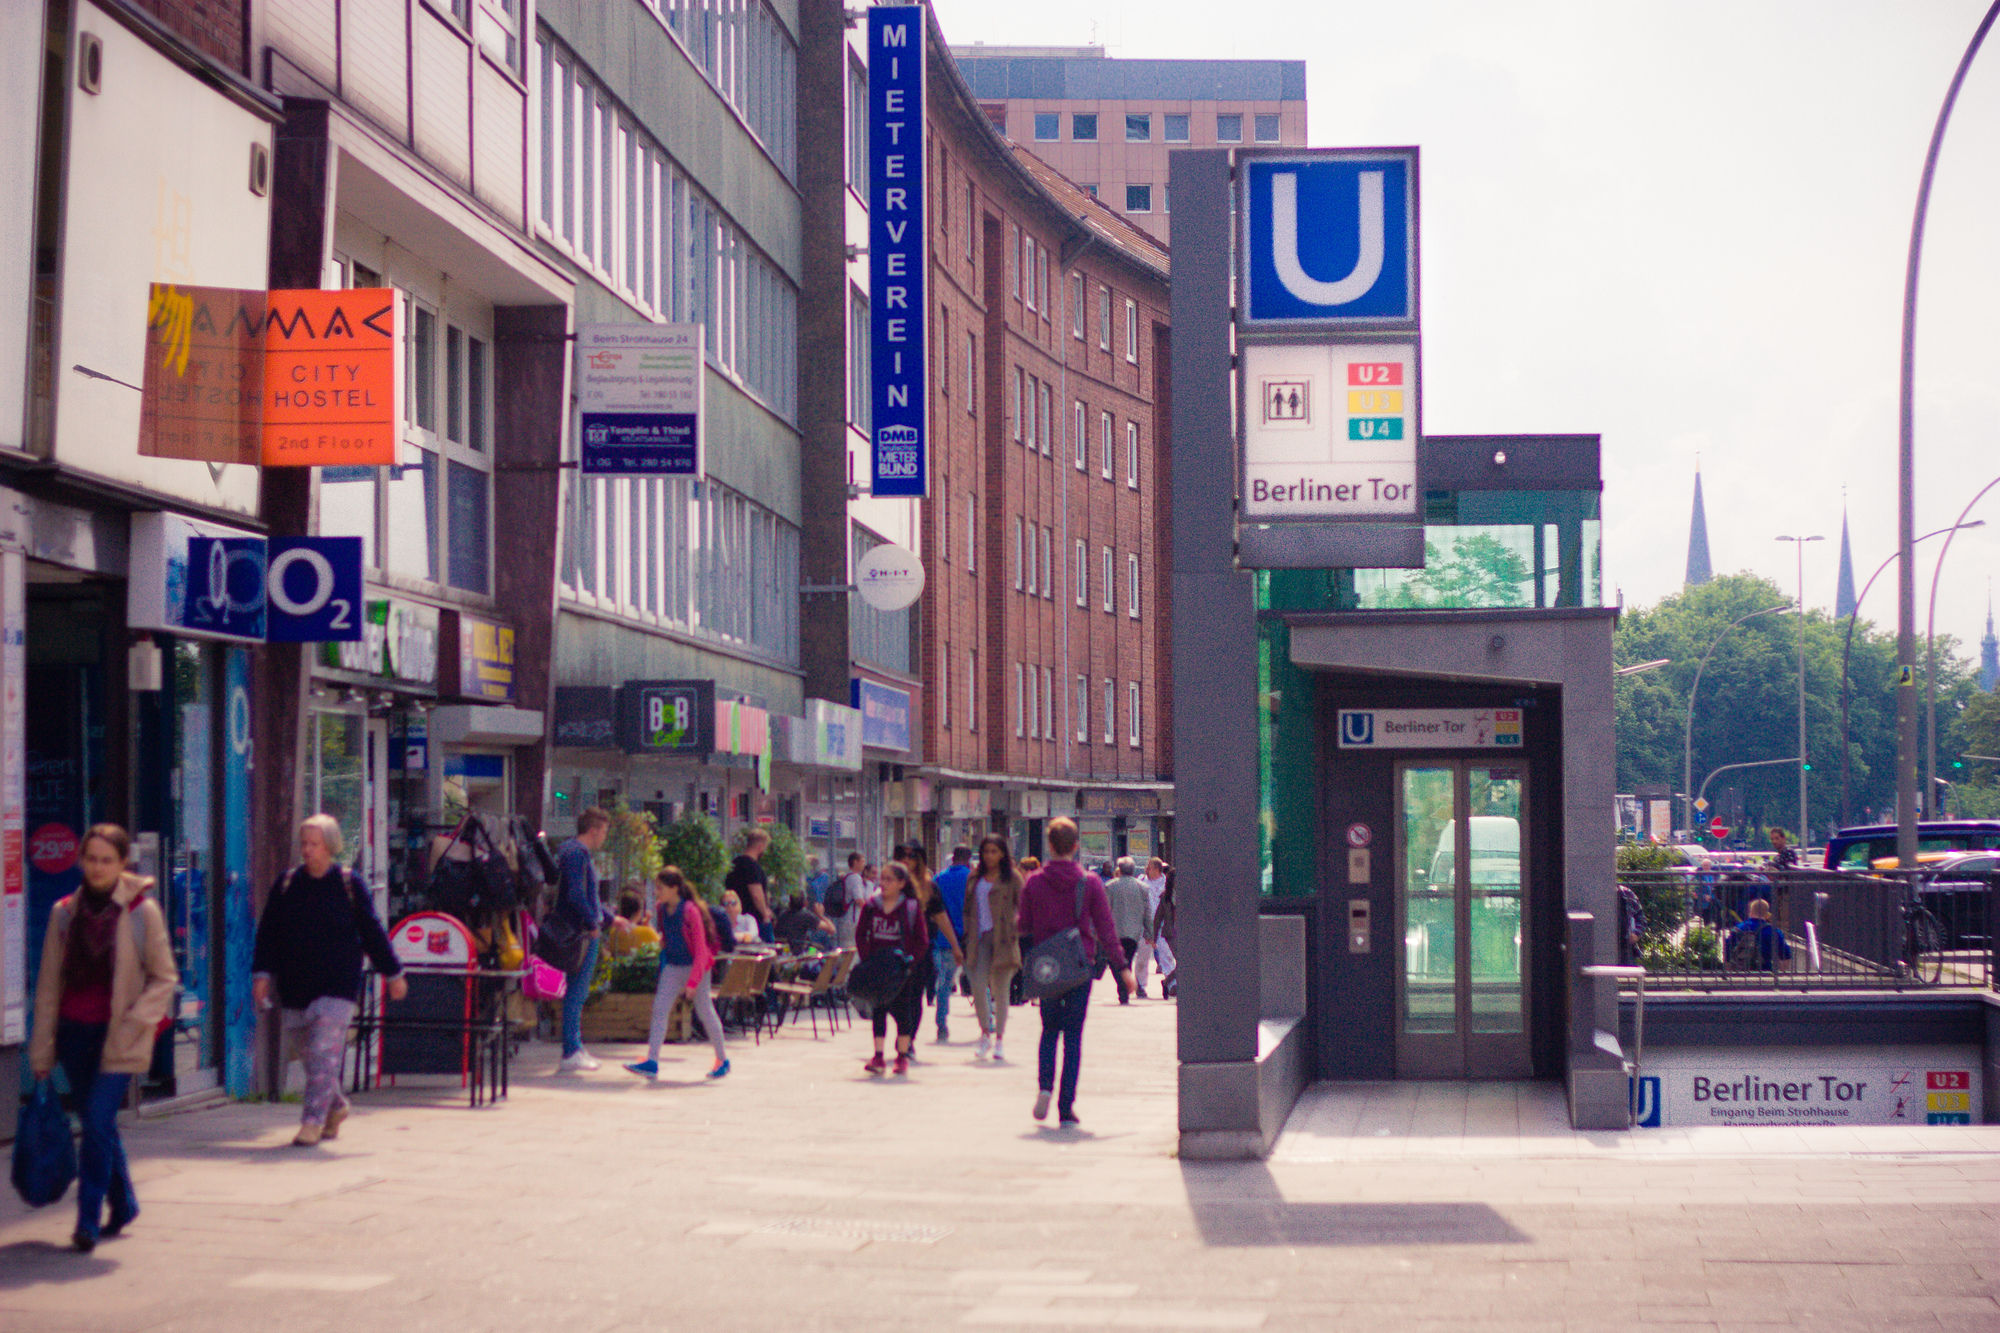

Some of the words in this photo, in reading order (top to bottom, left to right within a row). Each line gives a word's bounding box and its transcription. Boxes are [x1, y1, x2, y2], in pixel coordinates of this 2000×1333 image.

[882, 23, 908, 408] MIETERVEREIN
[1271, 170, 1385, 305] U
[266, 305, 392, 339] MAC
[291, 365, 361, 383] CITY
[1358, 366, 1390, 383] U2
[274, 389, 377, 408] HOSTEL
[1359, 392, 1391, 410] U3
[880, 430, 916, 442] DMB
[1358, 420, 1390, 438] U4
[279, 437, 309, 450] 2nd
[318, 435, 375, 449] Floor
[878, 463, 918, 475] BUND
[1252, 477, 1361, 502] Berliner
[1368, 478, 1412, 502] Tor
[1346, 715, 1370, 743] U
[1384, 720, 1440, 734] Berliner
[1443, 720, 1466, 734] Tor
[1693, 1075, 1812, 1102] Berliner
[1817, 1076, 1867, 1102] Tor
[1935, 1073, 1960, 1087] U2
[1936, 1094, 1961, 1109] U3
[1710, 1107, 1755, 1119] Eingang
[1758, 1106, 1785, 1117] Beim
[1787, 1106, 1850, 1117] Strohhause
